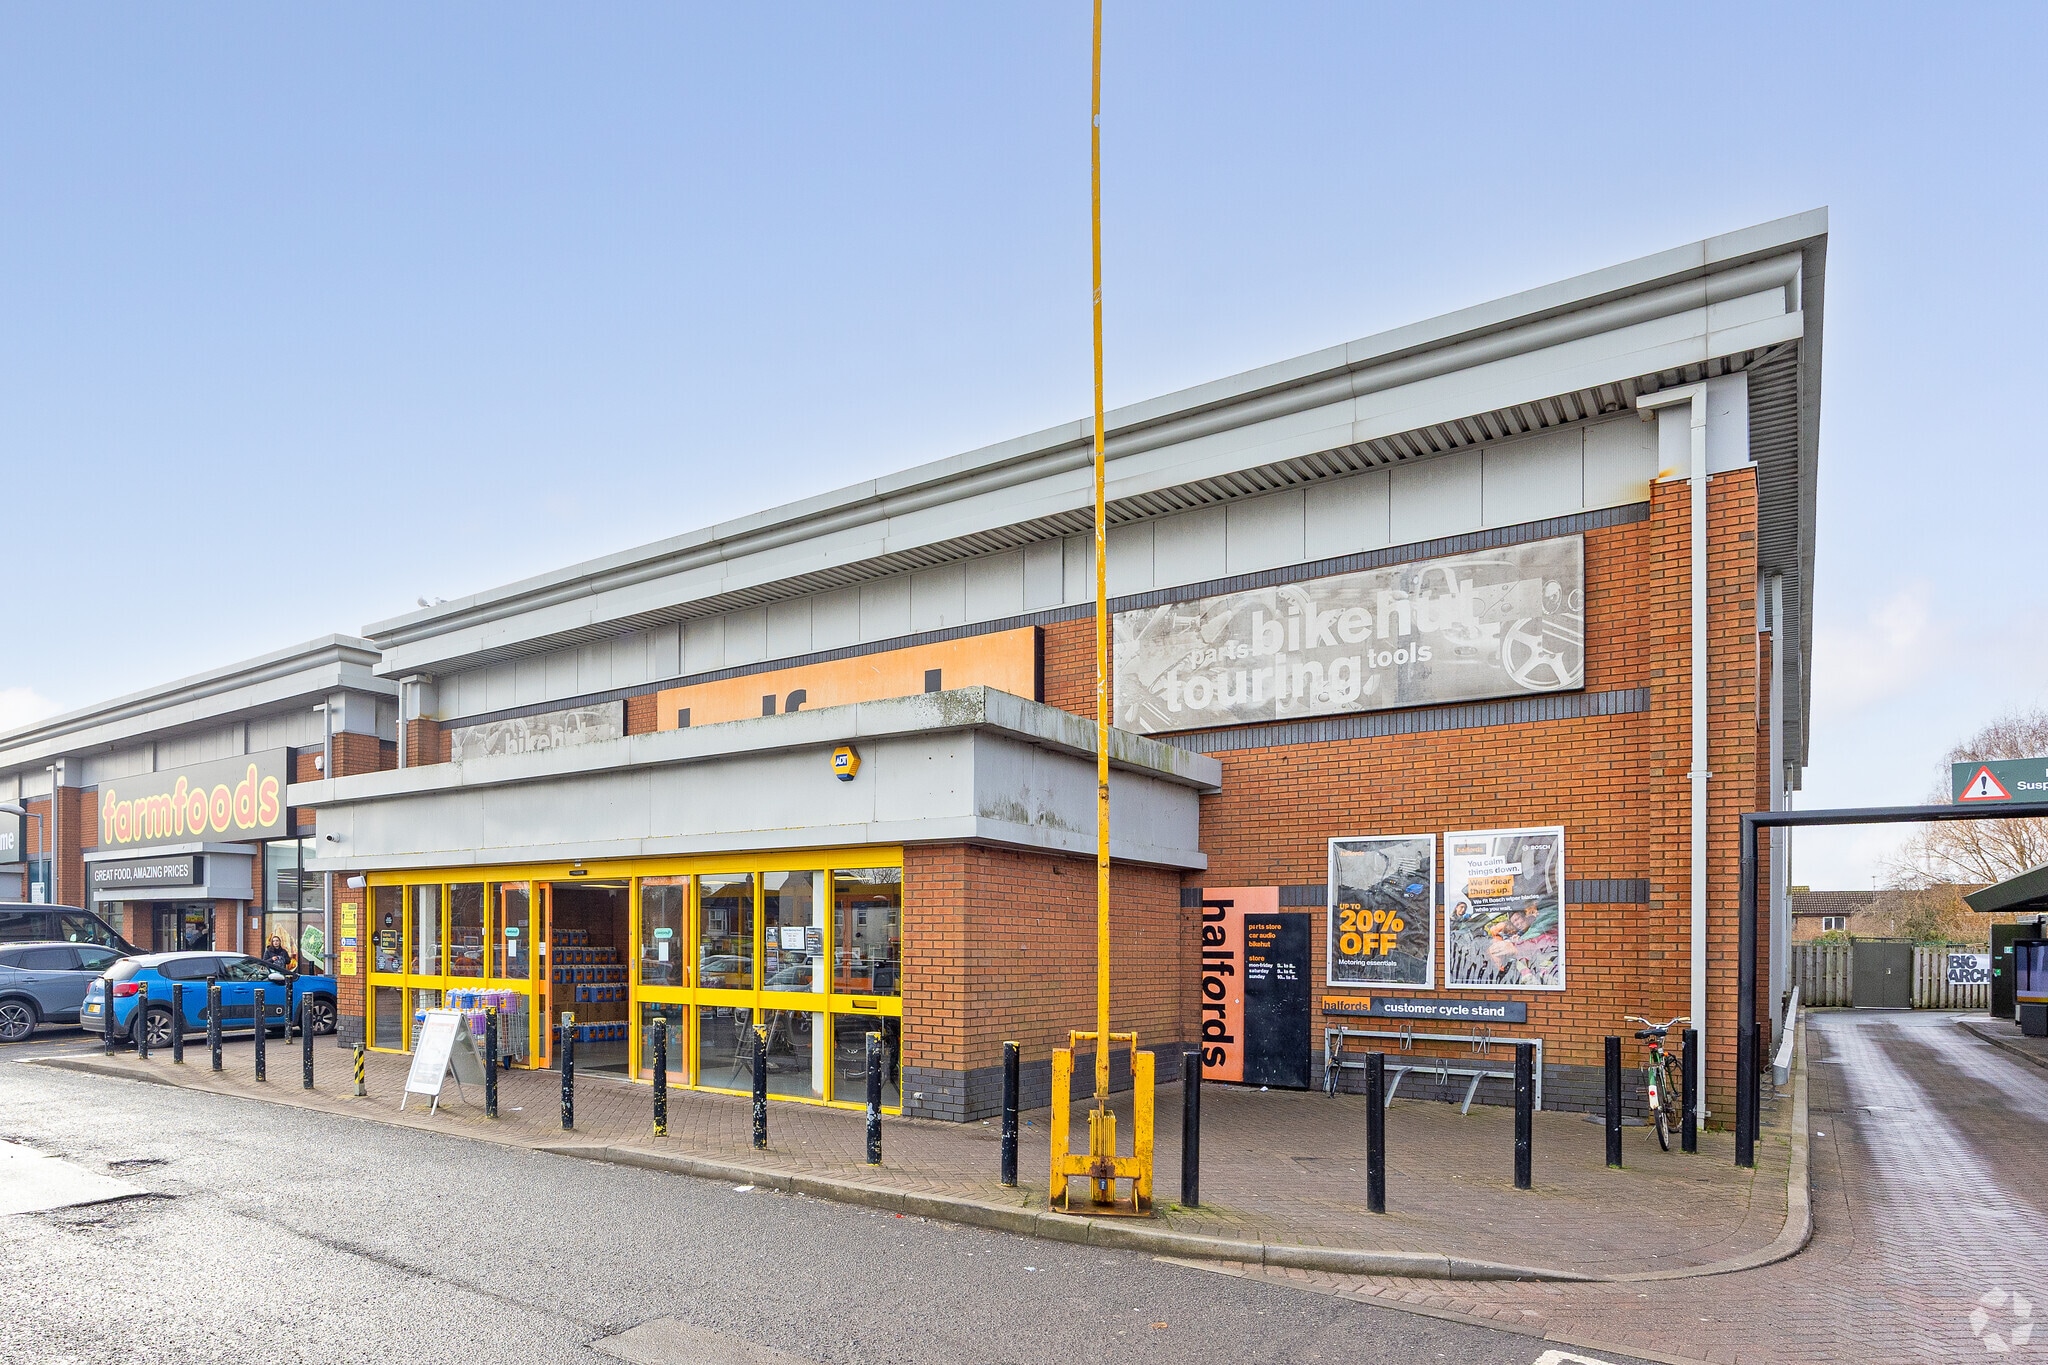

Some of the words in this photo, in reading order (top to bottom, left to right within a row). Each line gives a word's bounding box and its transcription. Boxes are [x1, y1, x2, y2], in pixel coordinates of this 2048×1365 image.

[1253, 579, 1479, 656] bikehut
[1191, 640, 1249, 669] parts
[1367, 642, 1432, 668] tools
[1165, 653, 1361, 712] touring
[836, 755, 848, 766] ADT
[103, 763, 279, 845] farmfoods
[95, 868, 114, 881] GREAT
[114, 867, 132, 881] FOOD,
[133, 866, 162, 879] AMAZING
[163, 864, 188, 877] PRICES
[1468, 868, 1493, 876] things
[1470, 887, 1495, 895] things
[1496, 887, 1509, 895] up.
[1339, 910, 1405, 932] 20%
[1339, 932, 1397, 956] OFF
[1339, 959, 1365, 967] Motoring
[1366, 959, 1397, 967] essentials
[1949, 954, 1978, 969] BIG
[1202, 899, 1235, 1067] halfords
[1948, 968, 1990, 983] ARCH
[1323, 1000, 1368, 1011] halfords
[1384, 1003, 1437, 1014] customer
[1439, 1004, 1469, 1016] cycle
[1471, 1006, 1505, 1017] stand
